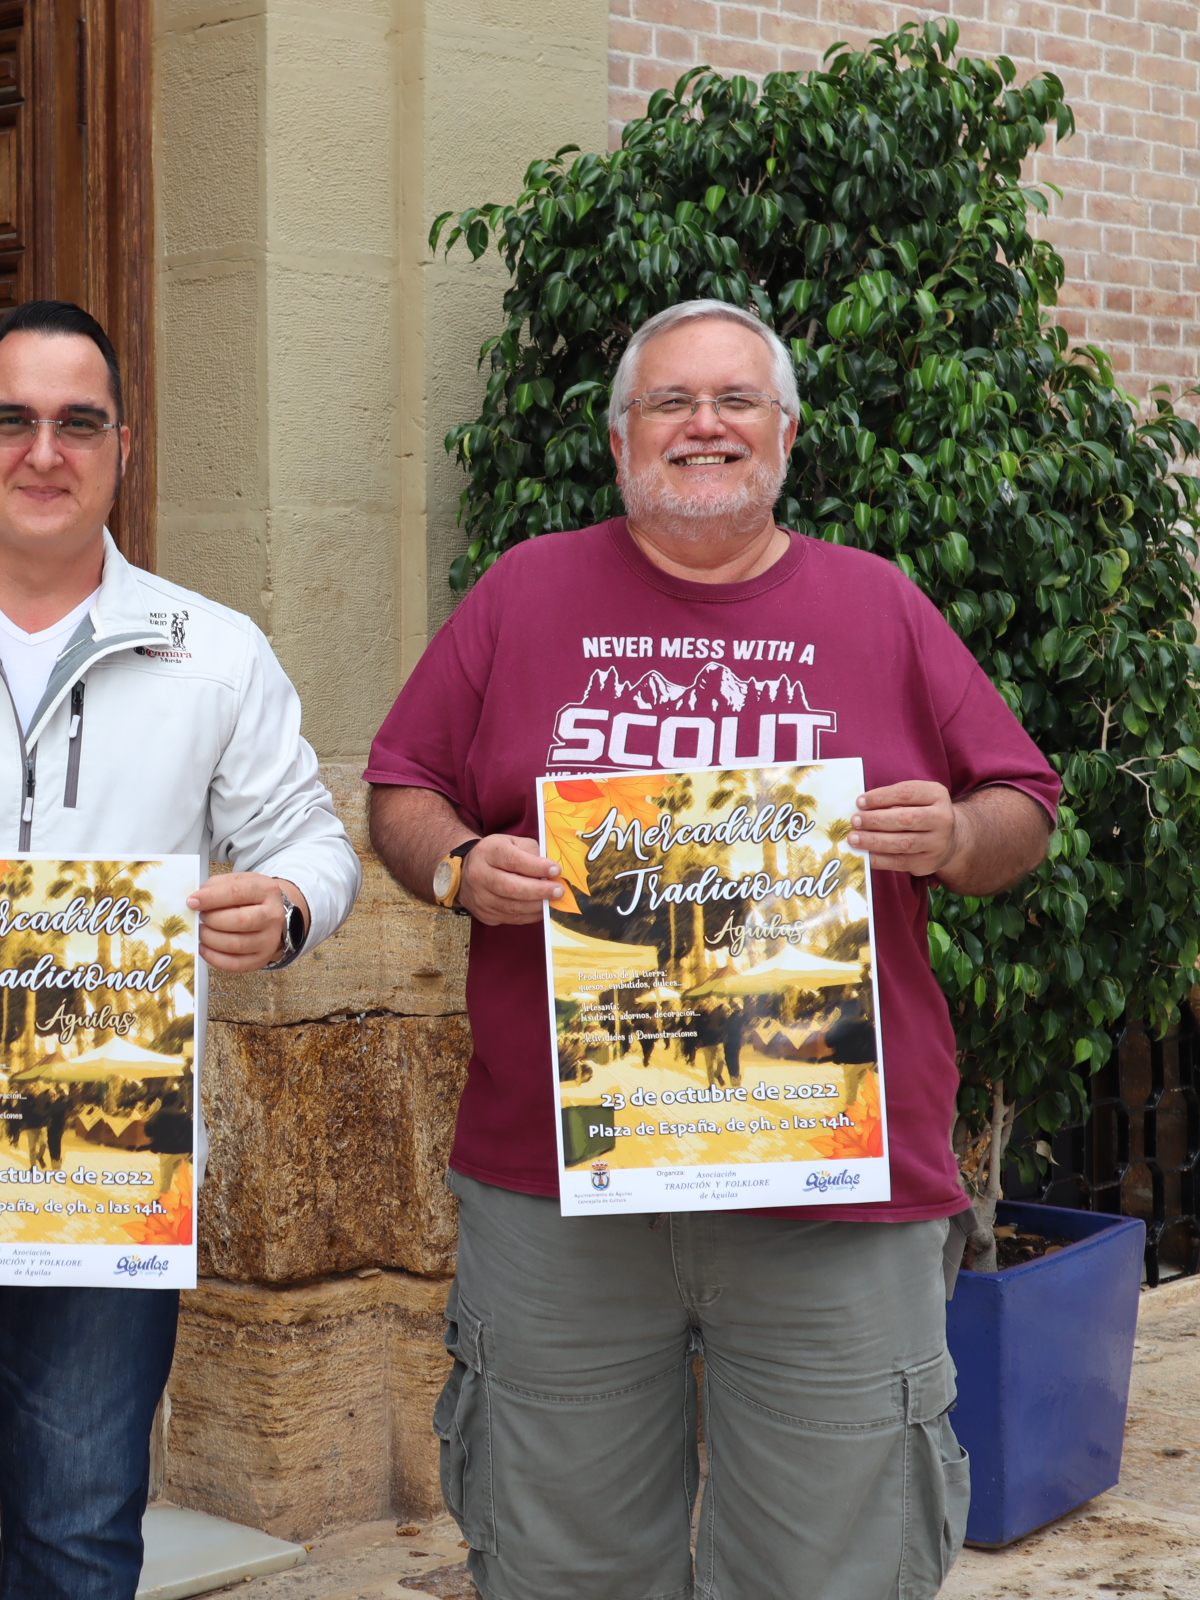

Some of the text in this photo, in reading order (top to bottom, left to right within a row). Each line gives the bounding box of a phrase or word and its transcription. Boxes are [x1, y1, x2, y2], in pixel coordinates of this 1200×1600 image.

[582, 637, 815, 665] NEVER MESS WITH A
[552, 708, 831, 769] SCOUT
[583, 803, 815, 861] Mercadillo
[614, 859, 841, 916] Tradicional
[704, 910, 805, 956] Águilas
[578, 971, 617, 981] Productos
[621, 970, 629, 978] de
[632, 969, 639, 978] la
[35, 999, 136, 1044] Águilas
[628, 1035, 634, 1044] y
[601, 1082, 839, 1111] 23 de octubre de 2022
[589, 1113, 855, 1138] Plaza de España, de 9h. a las 14h.
[71, 1167, 97, 1184] de
[102, 1171, 154, 1185] 2022
[665, 1180, 711, 1190] TRADICIÓN
[725, 1179, 770, 1187] FOLKLORE
[44, 1199, 63, 1213] de
[67, 1199, 92, 1216] 9h.
[96, 1203, 105, 1213] a
[108, 1200, 130, 1213] las
[134, 1201, 167, 1216] 14h.
[711, 1191, 738, 1199] Águilas
[25, 1268, 51, 1277] Águilas
